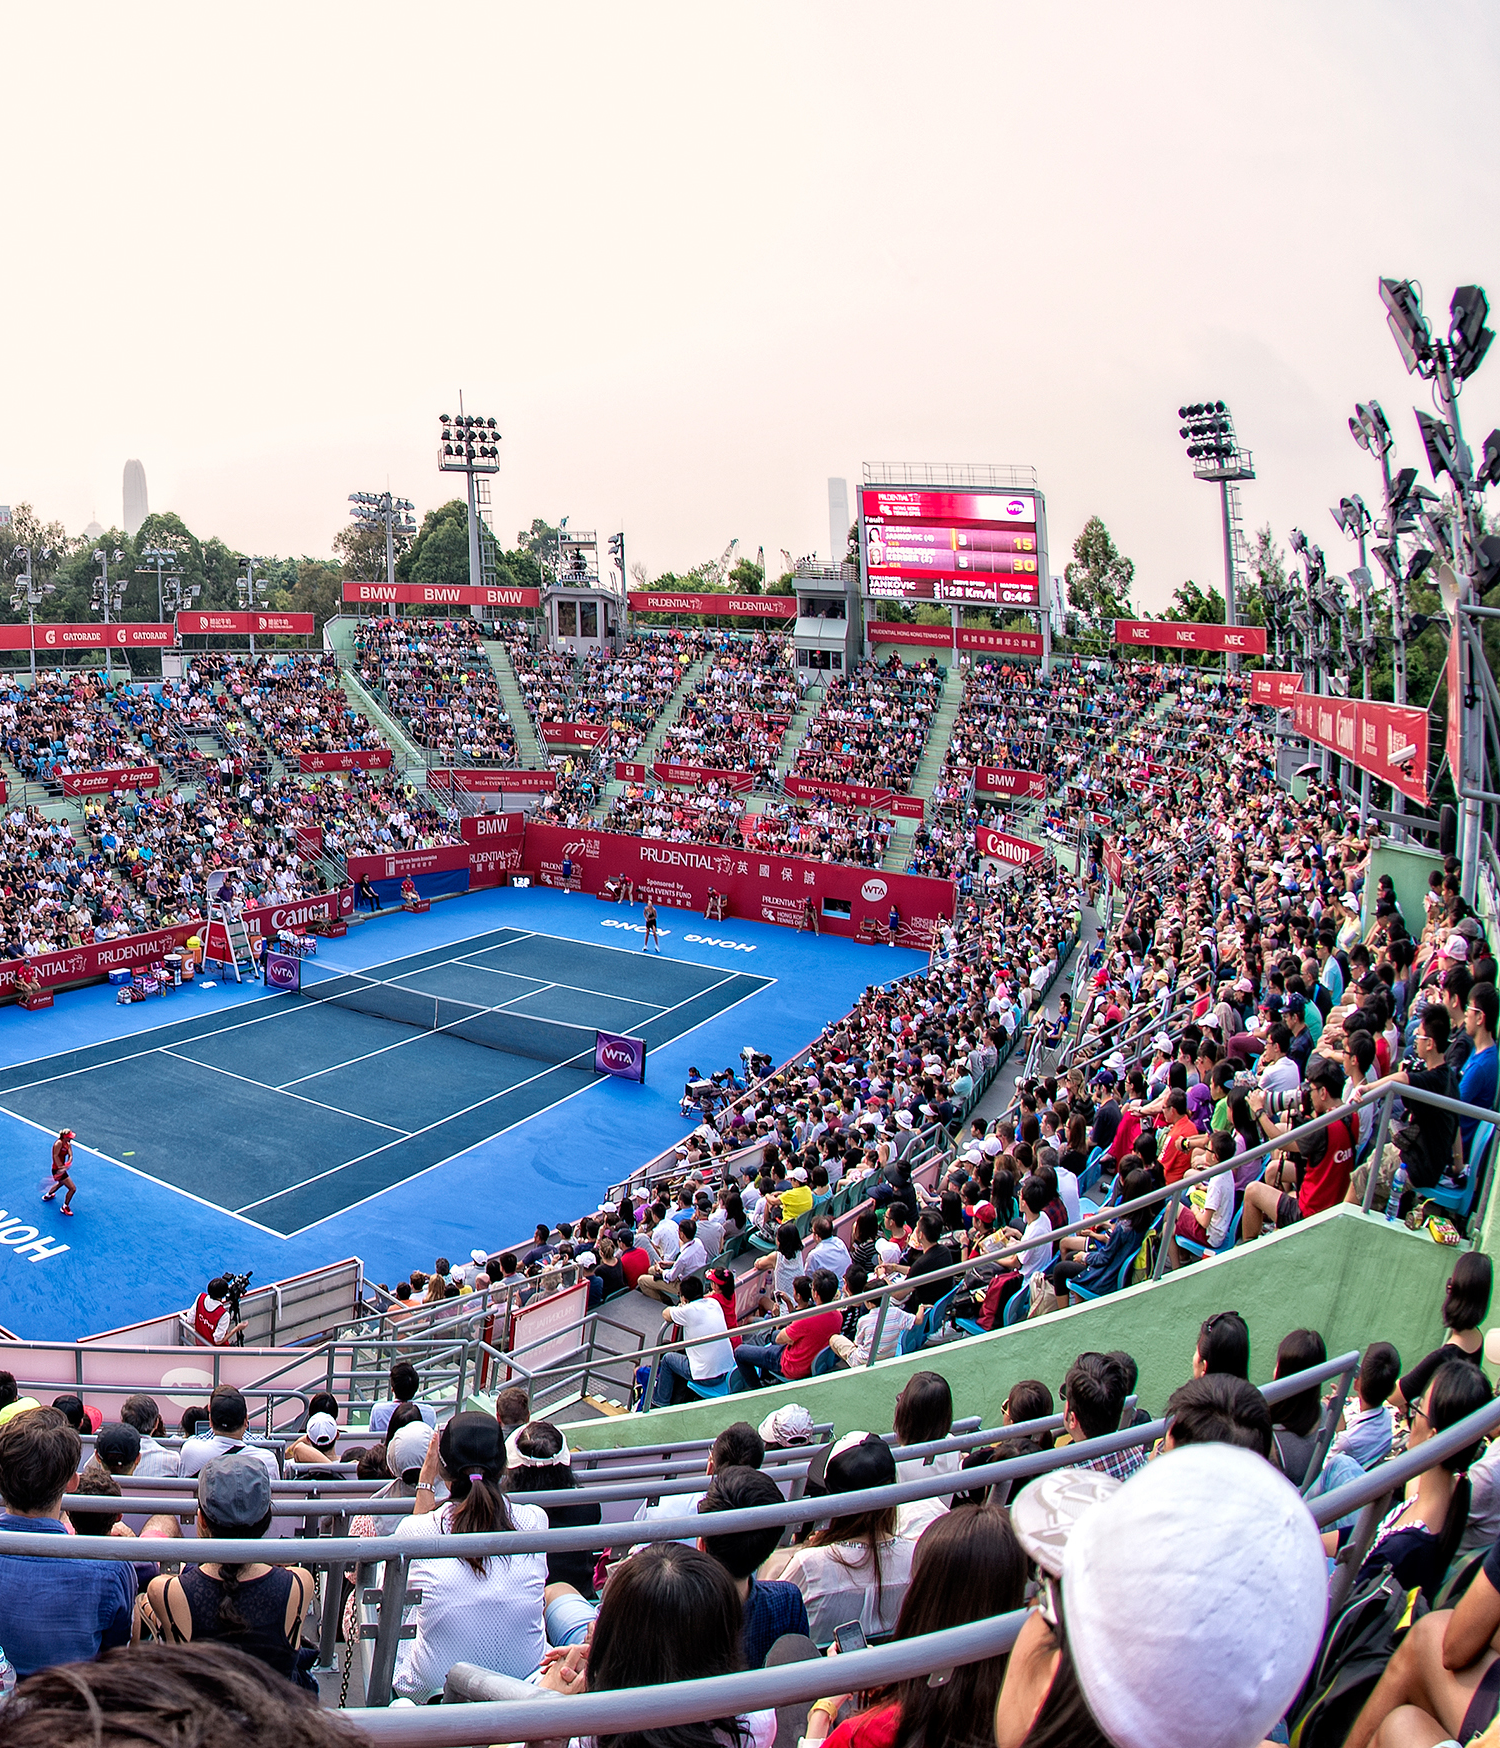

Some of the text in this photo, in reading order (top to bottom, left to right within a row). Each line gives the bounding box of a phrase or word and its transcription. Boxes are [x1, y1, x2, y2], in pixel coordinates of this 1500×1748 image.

[864, 516, 885, 524] Fault
[885, 533, 935, 543] JANKOVIC (4)
[958, 534, 967, 546] 3
[1013, 538, 1033, 551] 15
[885, 553, 920, 563] KERBER
[958, 556, 968, 569] 5
[1013, 558, 1036, 572] 30
[868, 580, 941, 592] JANKOVIC 2
[869, 588, 905, 597] KERBER
[943, 585, 995, 600] 128 Km/h
[359, 586, 523, 604] BMW BMW BMW
[1002, 592, 1032, 603] 0:46
[647, 597, 774, 612] PRUDENTIAL PRUDENTIAL
[63, 632, 101, 641] GATORADE
[132, 631, 168, 640] GATORADE
[870, 628, 897, 636] PRUDENTIAL
[1132, 628, 1245, 646] NEC NEC NEC
[543, 728, 599, 740] NEC NEC
[1318, 706, 1333, 742] Canon
[1336, 709, 1354, 751] Canon
[83, 772, 154, 786] lotto lotto
[987, 773, 1016, 788] BMW
[477, 818, 509, 835] BMW
[987, 834, 1030, 863] Canon
[469, 850, 506, 864] RUDENTIAL
[640, 846, 714, 871] PRUDENTIAL
[540, 861, 566, 871] PRUDENT
[737, 860, 816, 885] 英國保誠
[646, 878, 684, 891] Sponsored by
[864, 884, 885, 896] WTA
[638, 885, 692, 900] MEGA EVENTS FUND
[761, 895, 796, 907] PRUDENTIAL
[271, 901, 330, 930] Canon
[777, 911, 792, 919] HONG
[777, 917, 794, 925] TENNIS
[911, 916, 928, 924] HONG
[911, 921, 929, 929] KONG
[600, 919, 757, 953] HONG KONG
[97, 940, 160, 965] PRUDENTIAL
[184, 957, 194, 970] G
[271, 965, 294, 979] WTA
[38, 996, 52, 1004] lotto
[604, 1048, 632, 1064] WTA
[1333, 1147, 1353, 1164] Can
